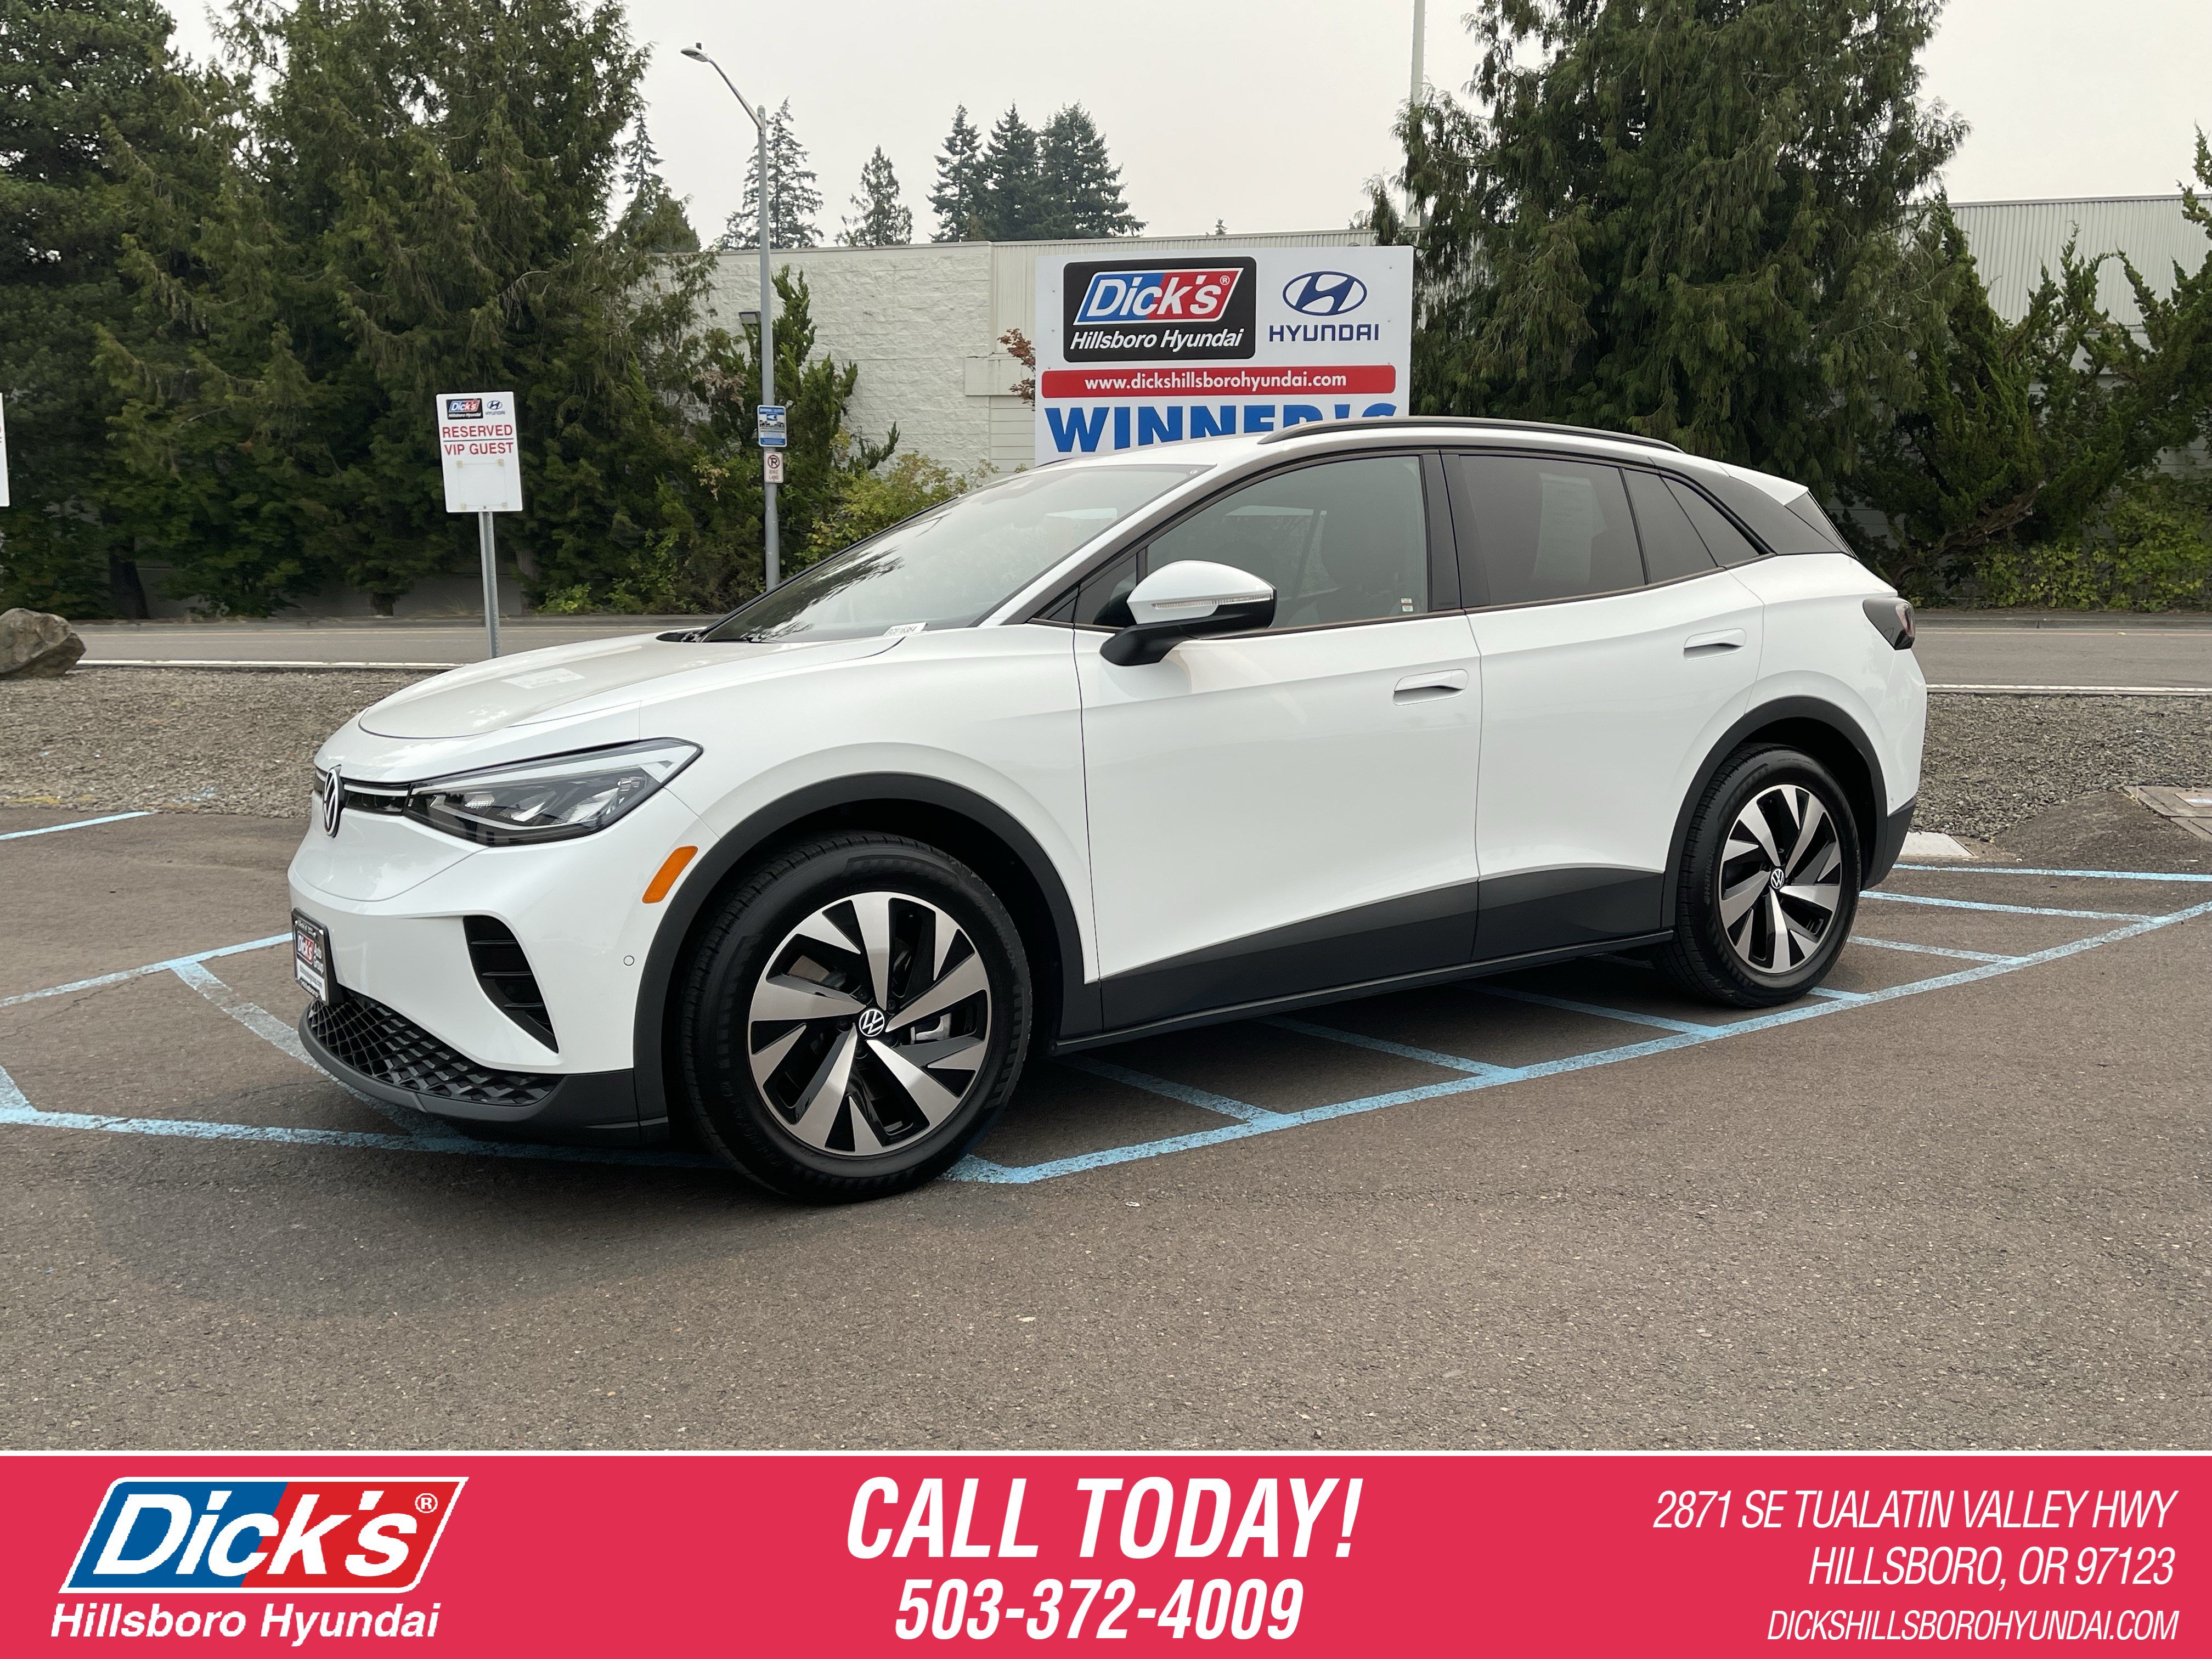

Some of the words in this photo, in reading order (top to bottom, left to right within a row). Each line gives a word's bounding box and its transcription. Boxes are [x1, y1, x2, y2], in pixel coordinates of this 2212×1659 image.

[1086, 275, 1222, 317] Dick's
[1070, 330, 1158, 349] Hillsboro
[1160, 329, 1244, 352] Hyundai
[1269, 324, 1379, 342] HYUNDAI
[1085, 370, 1347, 391] www.dickshillsborohyundai.com
[442, 424, 513, 438] RESERVED
[444, 444, 465, 455] VIP
[469, 442, 514, 455] GUEST
